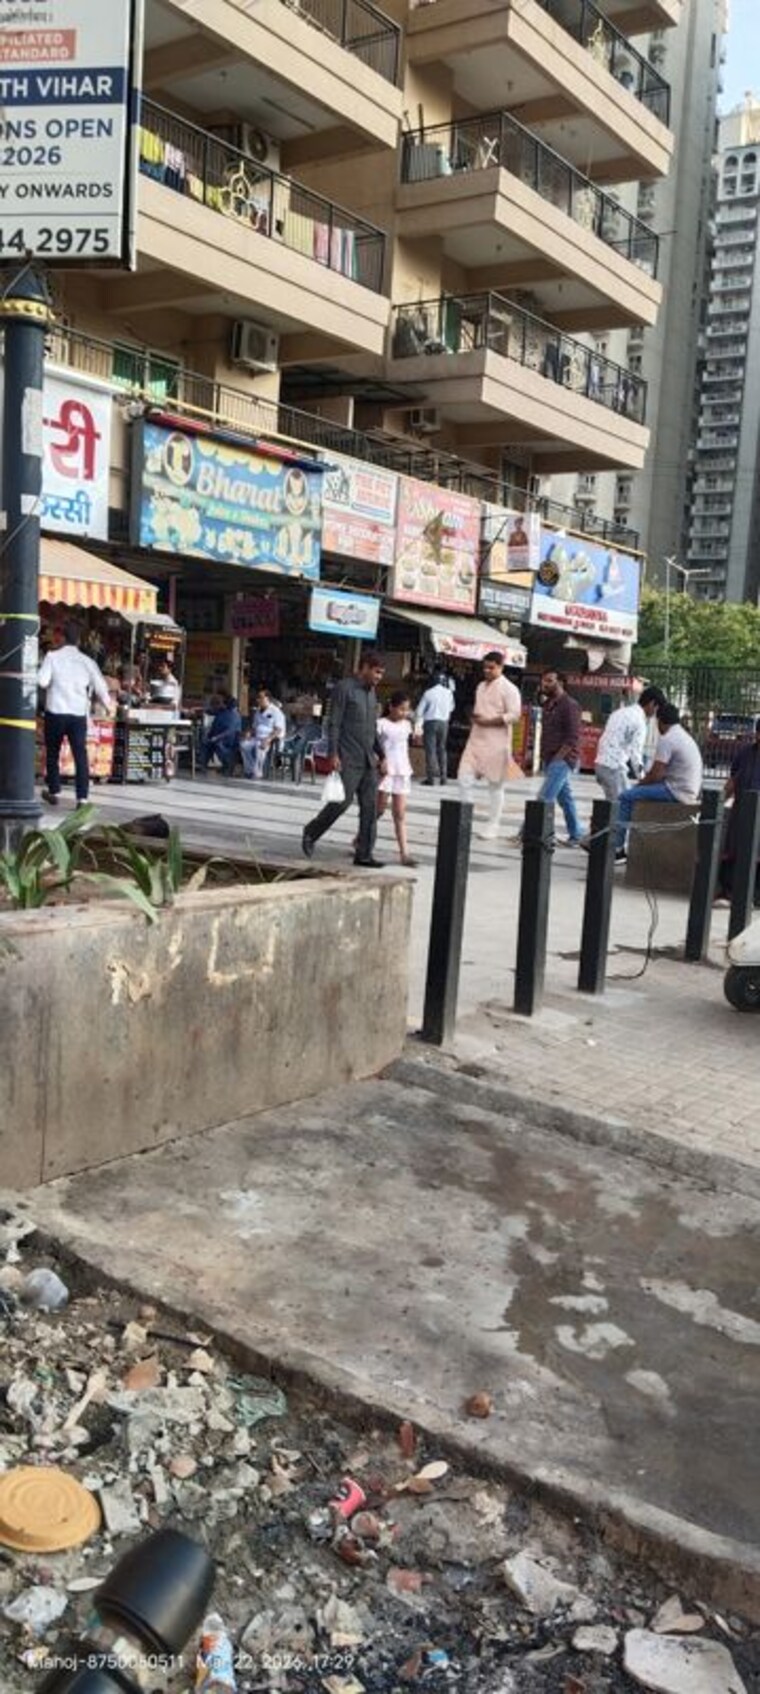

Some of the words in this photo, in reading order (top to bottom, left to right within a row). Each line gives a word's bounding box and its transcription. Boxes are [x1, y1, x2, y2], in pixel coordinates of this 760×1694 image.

[0, 46, 70, 60] TANDARD
[0, 76, 29, 98] TH
[36, 75, 113, 98] VIHAR
[45, 118, 114, 139] OPEN
[1, 145, 62, 166] 2026
[0, 183, 10, 199] Y
[15, 183, 114, 199] ONWARDS
[0, 228, 25, 253] 4
[36, 227, 110, 253] 2975
[196, 460, 282, 514] Bharat
